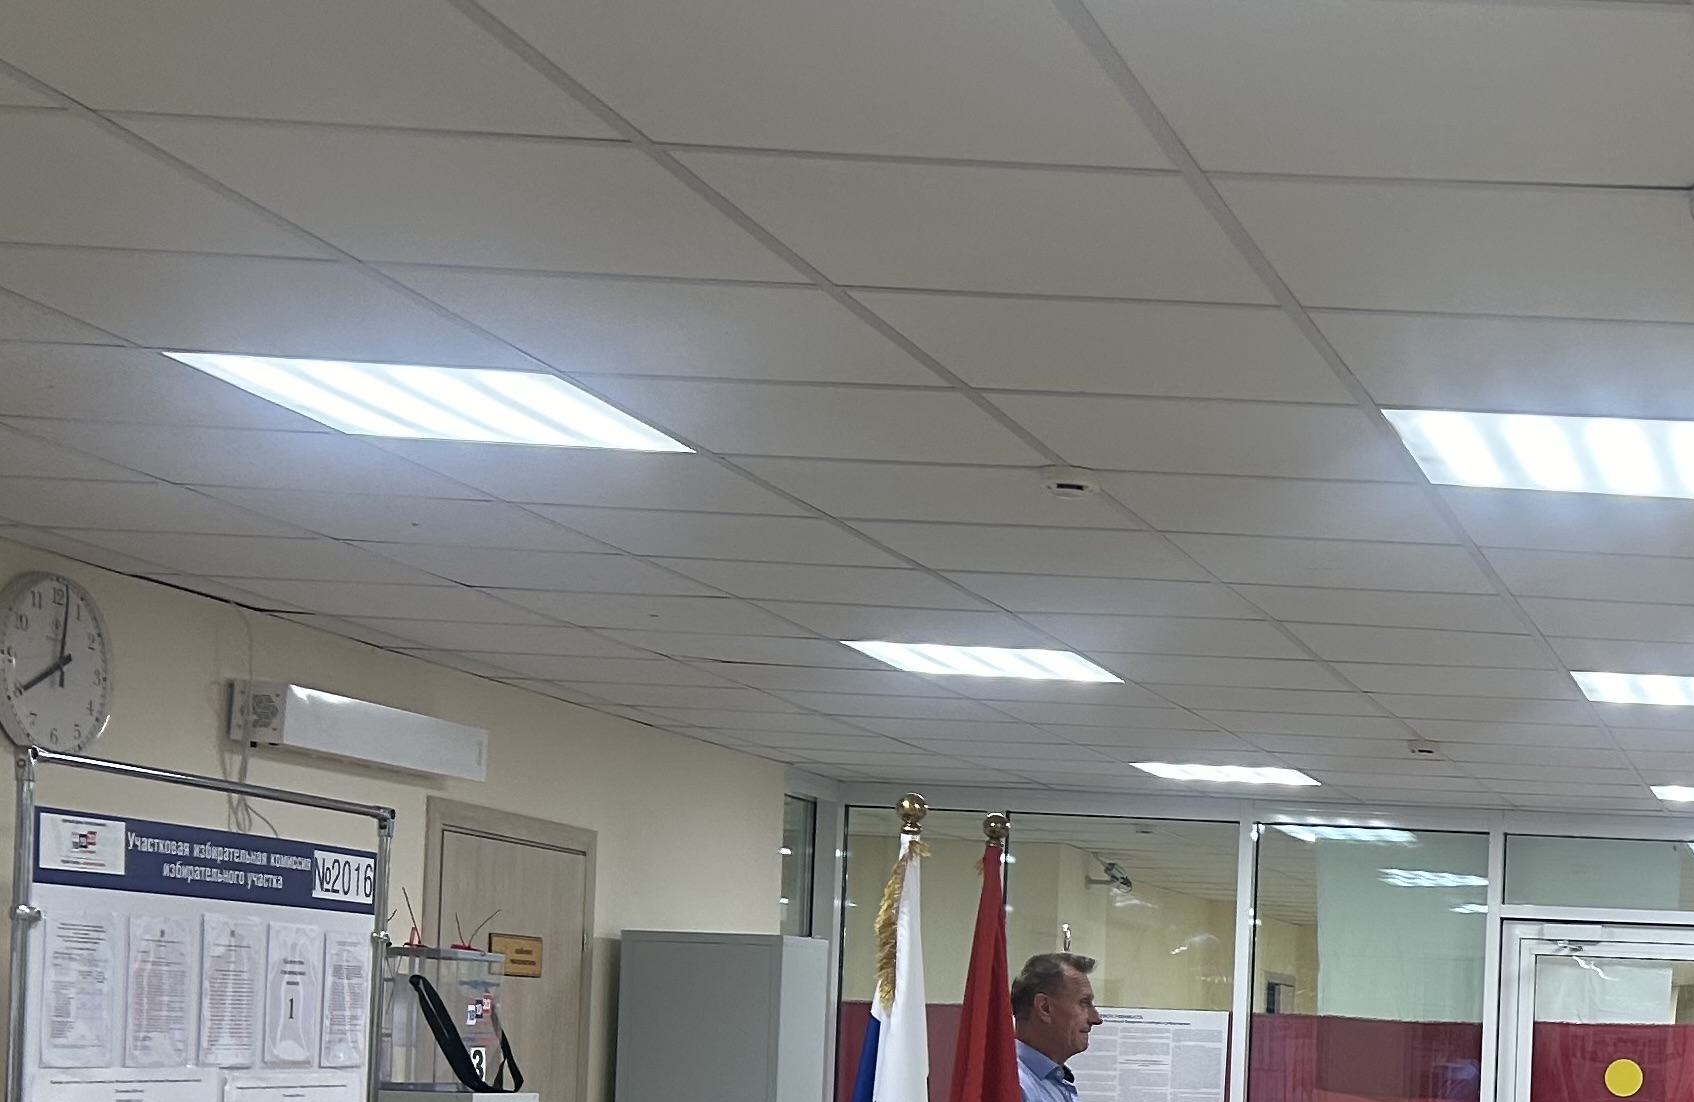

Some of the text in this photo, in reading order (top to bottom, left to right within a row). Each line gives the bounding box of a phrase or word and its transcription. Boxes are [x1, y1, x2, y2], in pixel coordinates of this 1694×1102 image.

[31, 590, 42, 609] 11
[52, 587, 64, 606] 12
[15, 613, 29, 632] 10
[87, 632, 95, 651] 2
[86, 700, 94, 716] 4
[50, 728, 59, 745] 6
[73, 723, 82, 741] 5
[127, 831, 190, 857] Участковая
[193, 841, 268, 867] избирательная
[162, 861, 283, 889] избирательного участка
[314, 857, 373, 898] №2016
